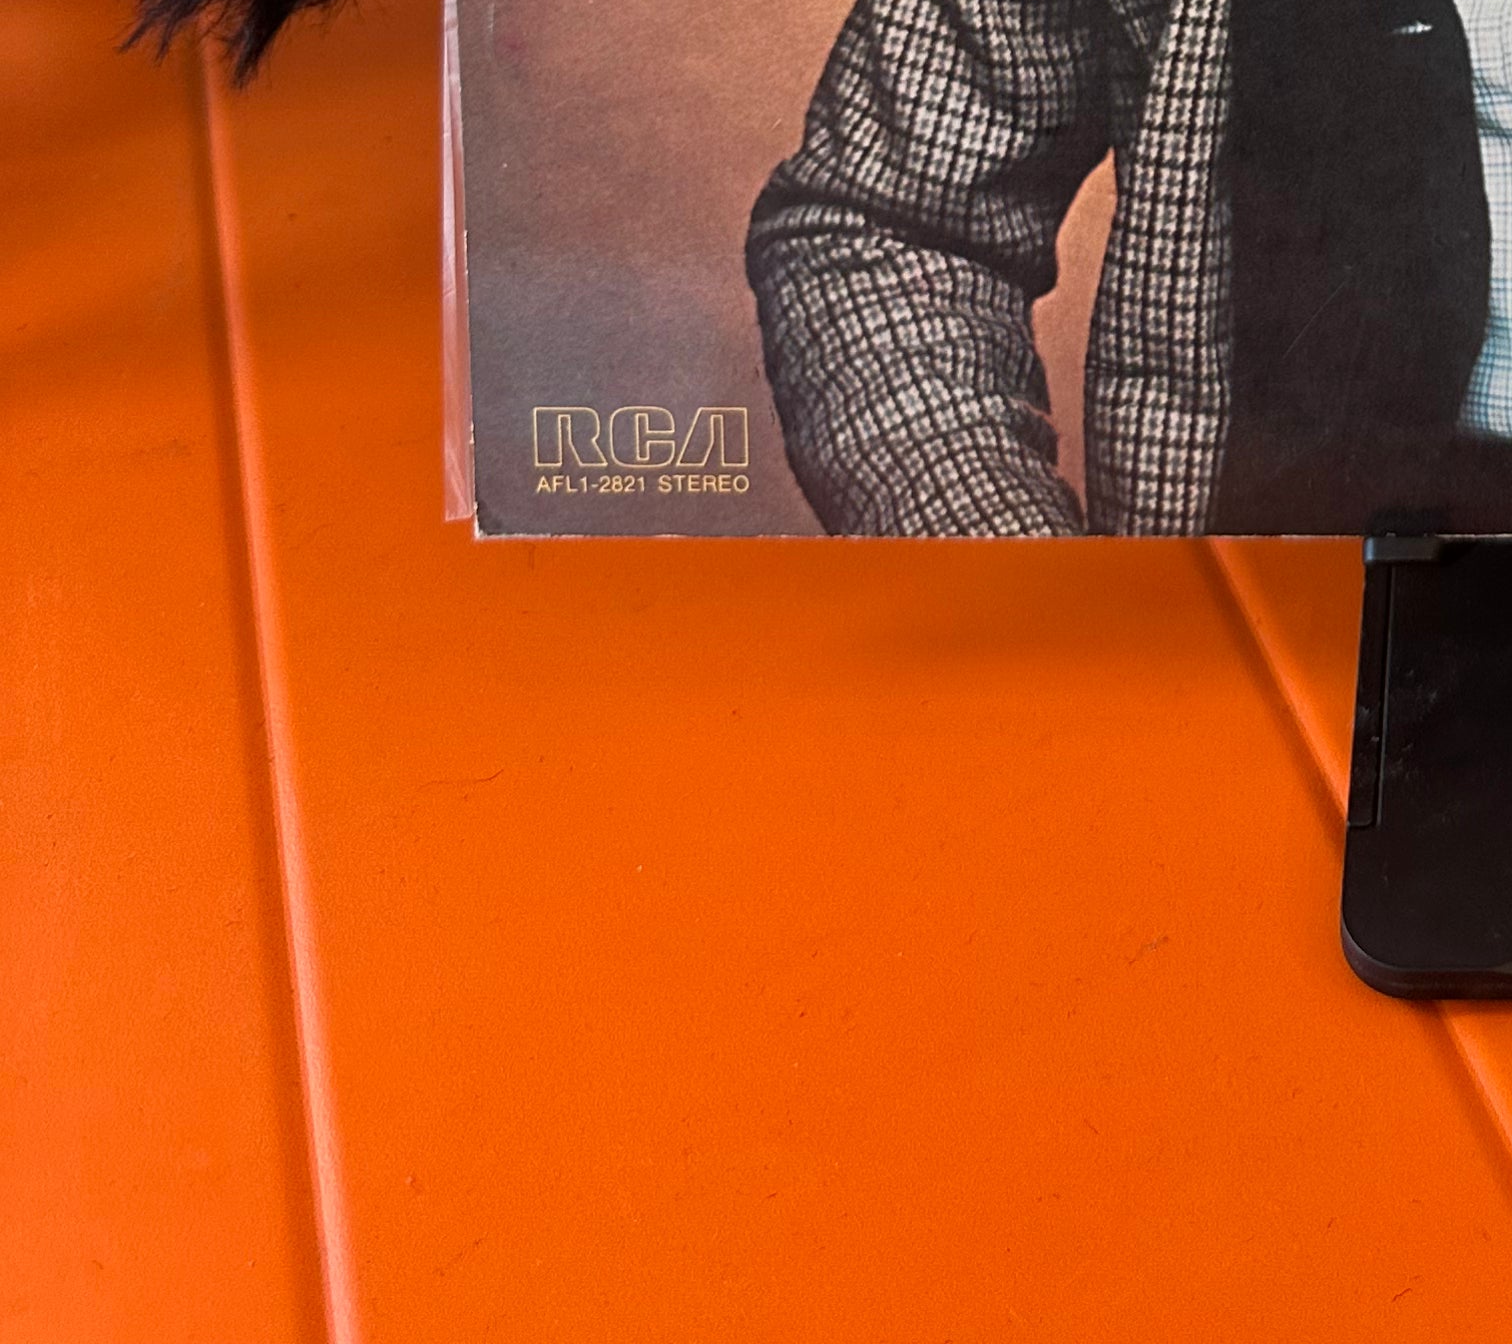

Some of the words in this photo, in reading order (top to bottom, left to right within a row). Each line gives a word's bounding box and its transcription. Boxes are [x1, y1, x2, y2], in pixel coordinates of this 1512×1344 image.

[532, 405, 750, 468] RCA
[535, 475, 646, 493] AFL1-2821
[657, 474, 750, 493] STEREO
